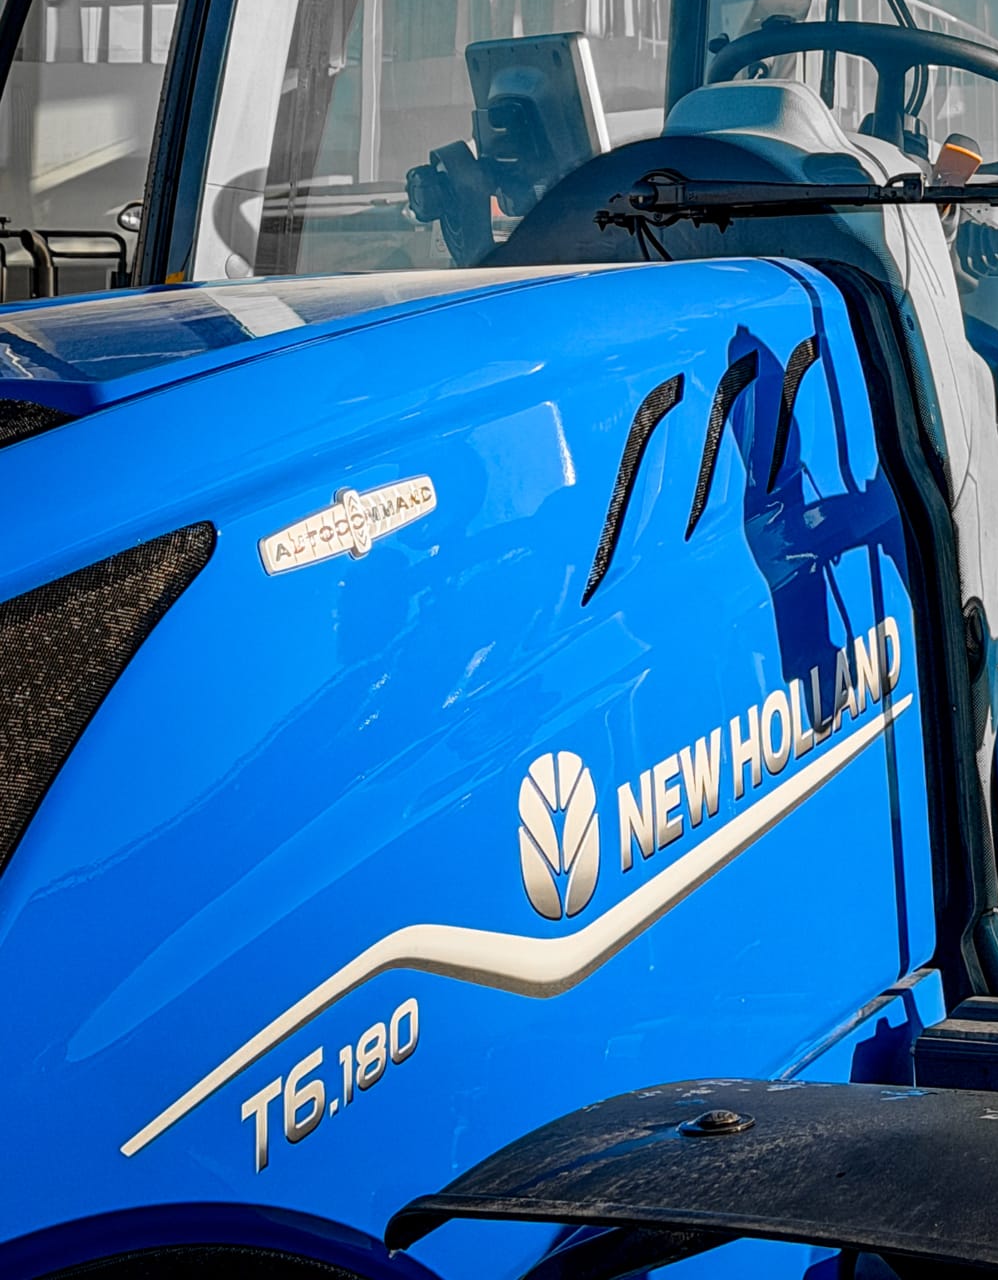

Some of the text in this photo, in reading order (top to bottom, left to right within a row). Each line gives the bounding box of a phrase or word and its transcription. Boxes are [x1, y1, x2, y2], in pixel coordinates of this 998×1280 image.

[616, 616, 900, 873] NEW HOLLAND
[241, 997, 419, 1175] T6.180
